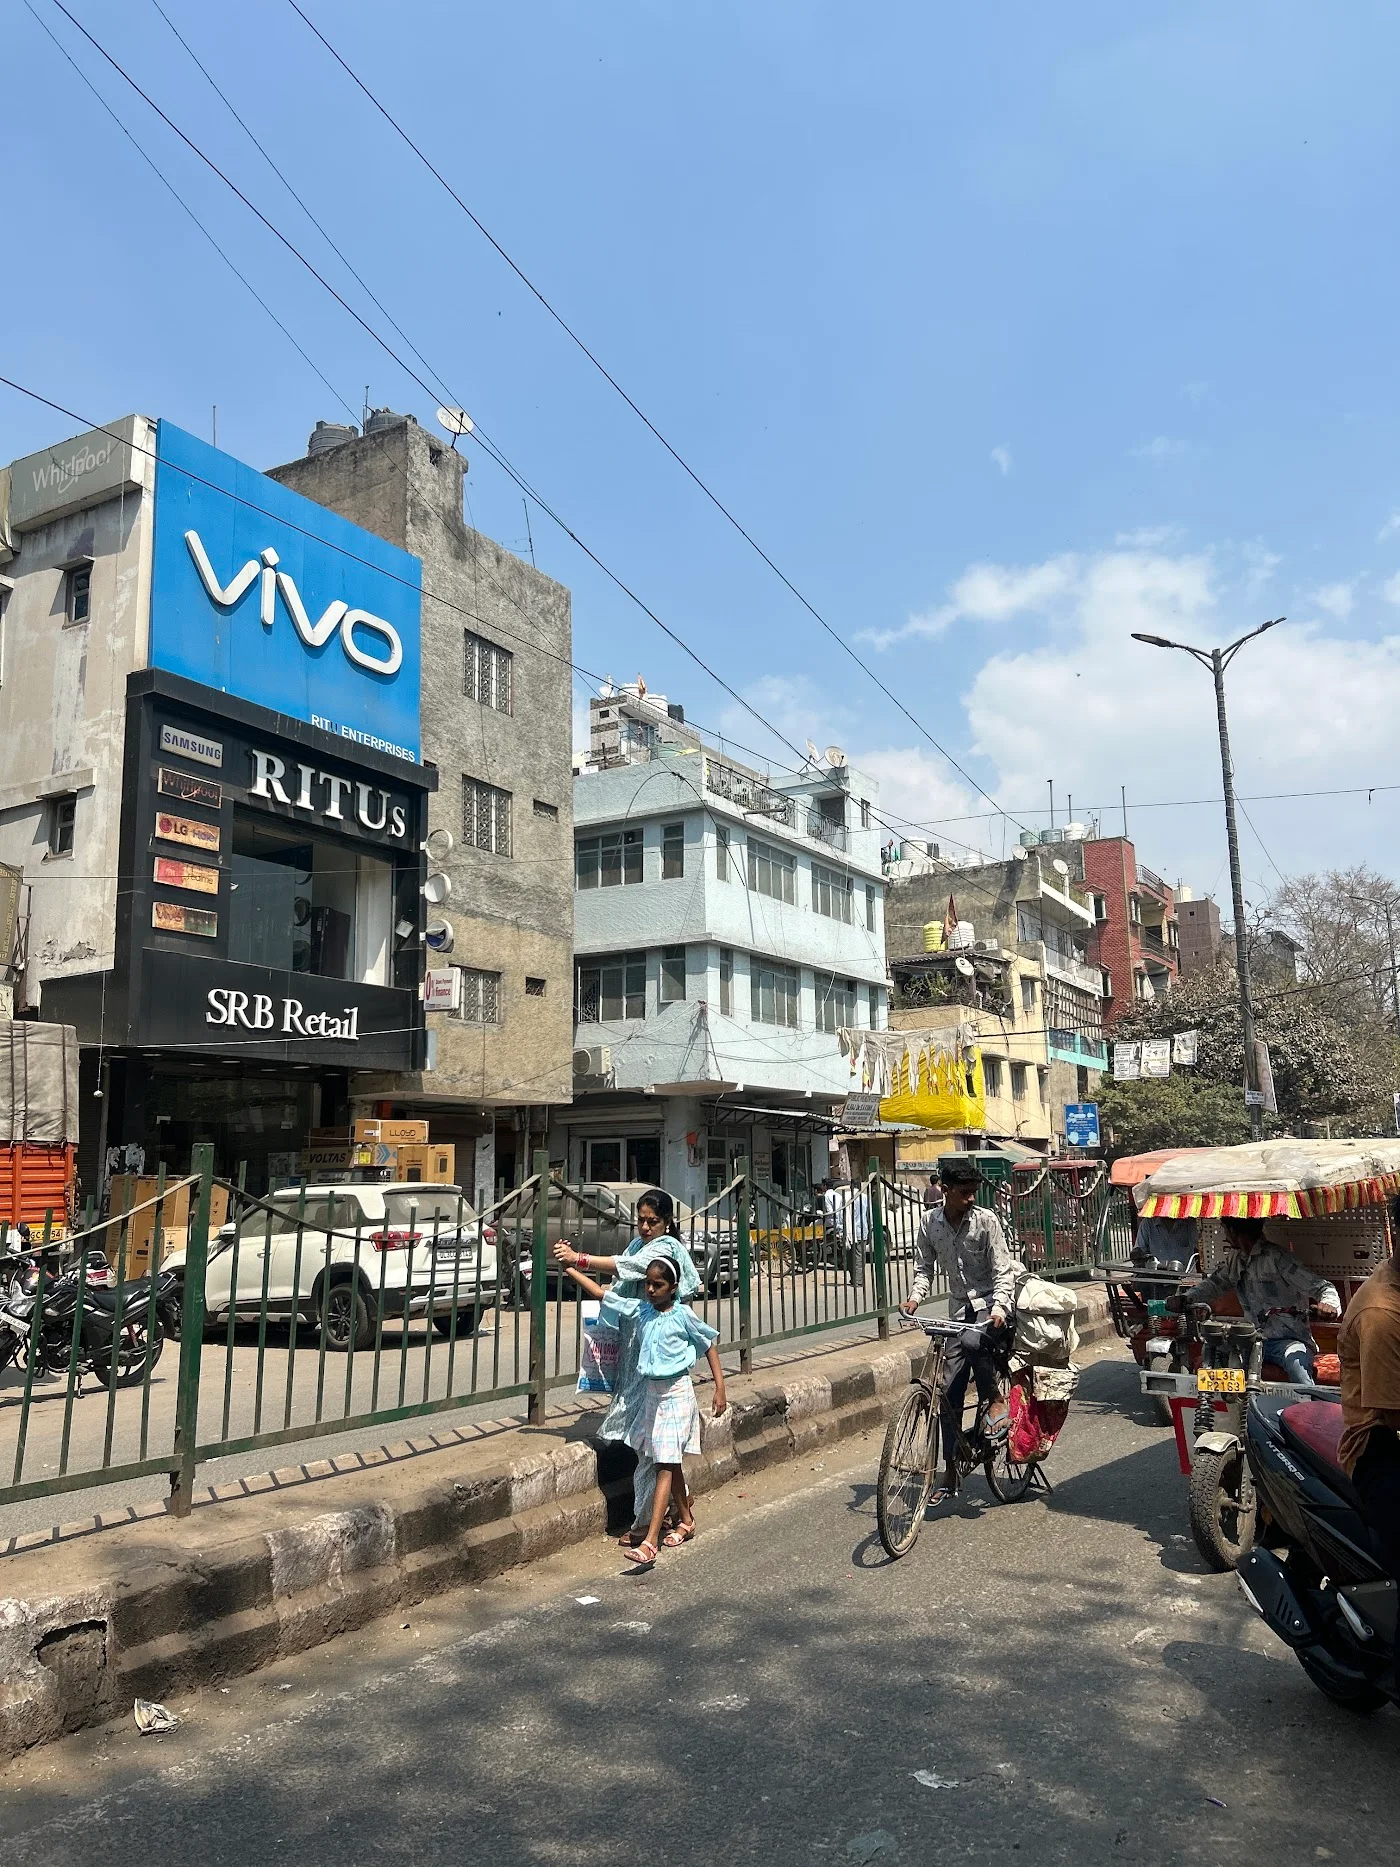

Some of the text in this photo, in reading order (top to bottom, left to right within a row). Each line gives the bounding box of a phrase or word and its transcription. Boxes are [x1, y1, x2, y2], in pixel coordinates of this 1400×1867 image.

[33, 441, 112, 494] Whirlpool
[185, 529, 402, 675] vivo
[164, 732, 221, 760] SAMSUNG
[341, 725, 416, 763] ENTERPRISES
[174, 822, 189, 836] LG
[205, 988, 360, 1041] SRB Retail
[309, 1152, 346, 1164] VOLTAS
[1207, 1381, 1240, 1392] R2163
[1265, 1441, 1298, 1473] NTORQ
